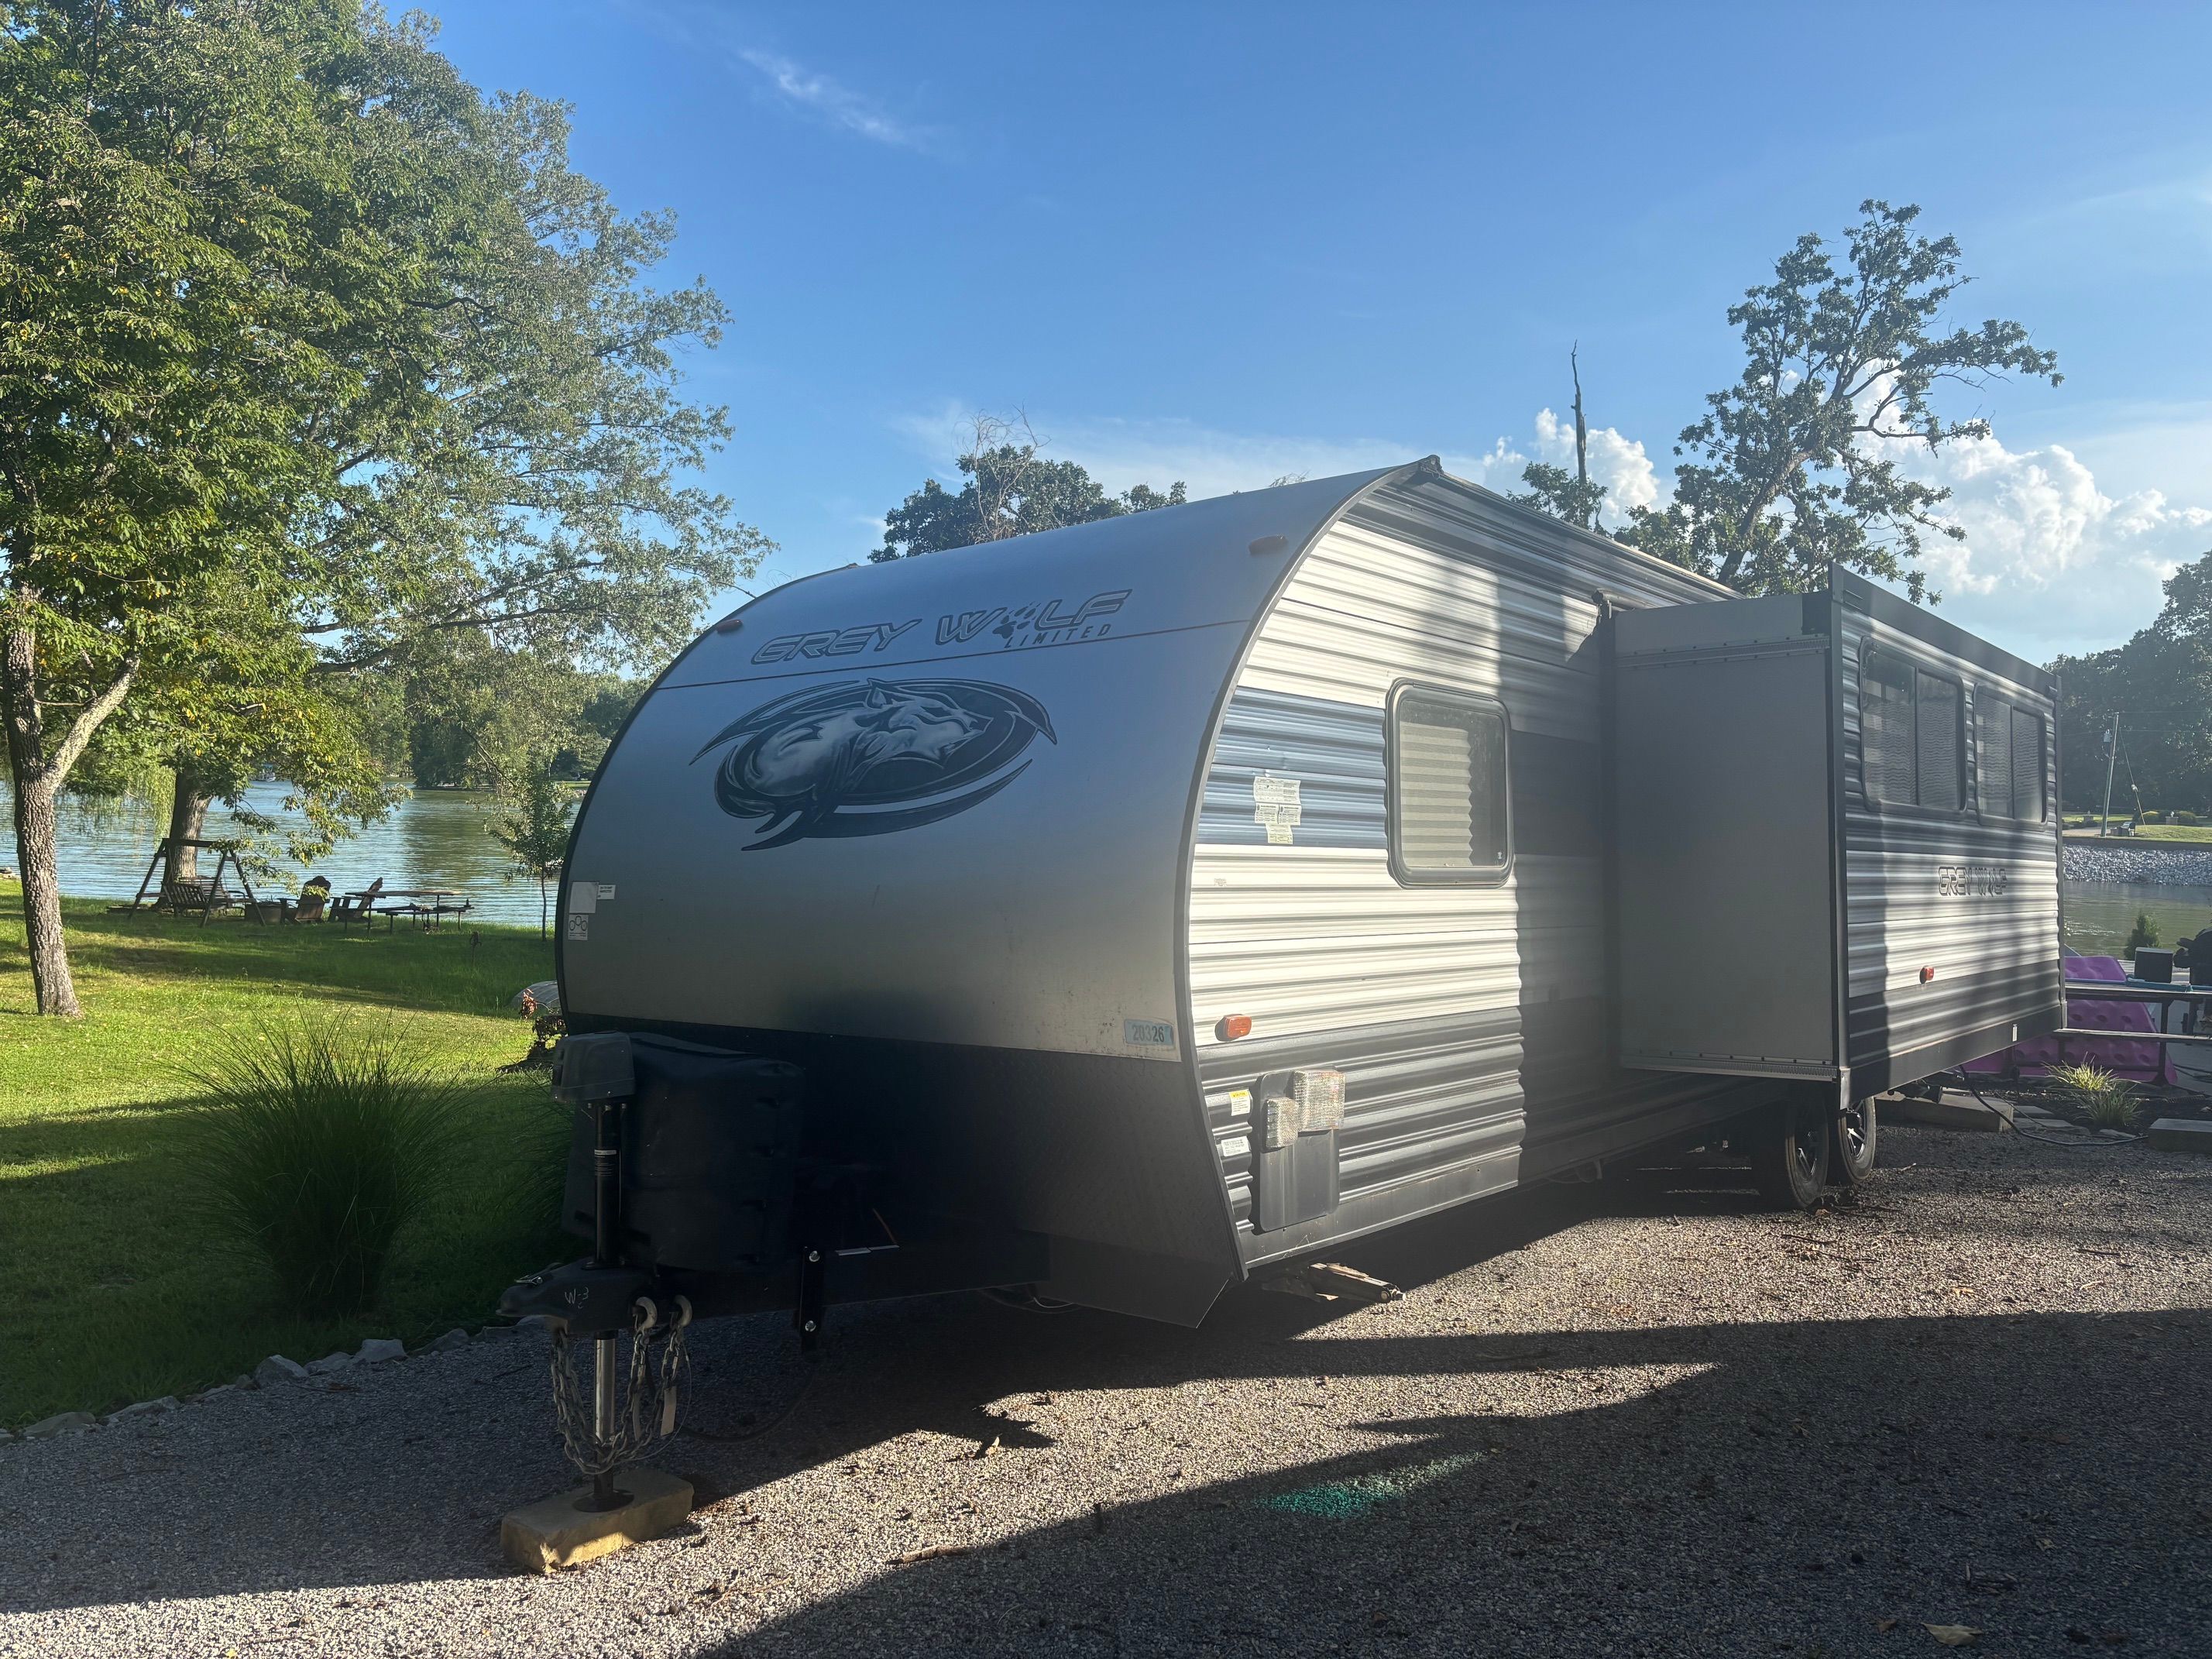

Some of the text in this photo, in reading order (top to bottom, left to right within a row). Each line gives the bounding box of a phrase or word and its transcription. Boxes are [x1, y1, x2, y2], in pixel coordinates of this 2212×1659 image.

[750, 618, 922, 665] GREY
[1004, 623, 1111, 648] LIMITED
[1939, 866, 1972, 896] GREY
[1132, 1024, 1165, 1042] 20326
